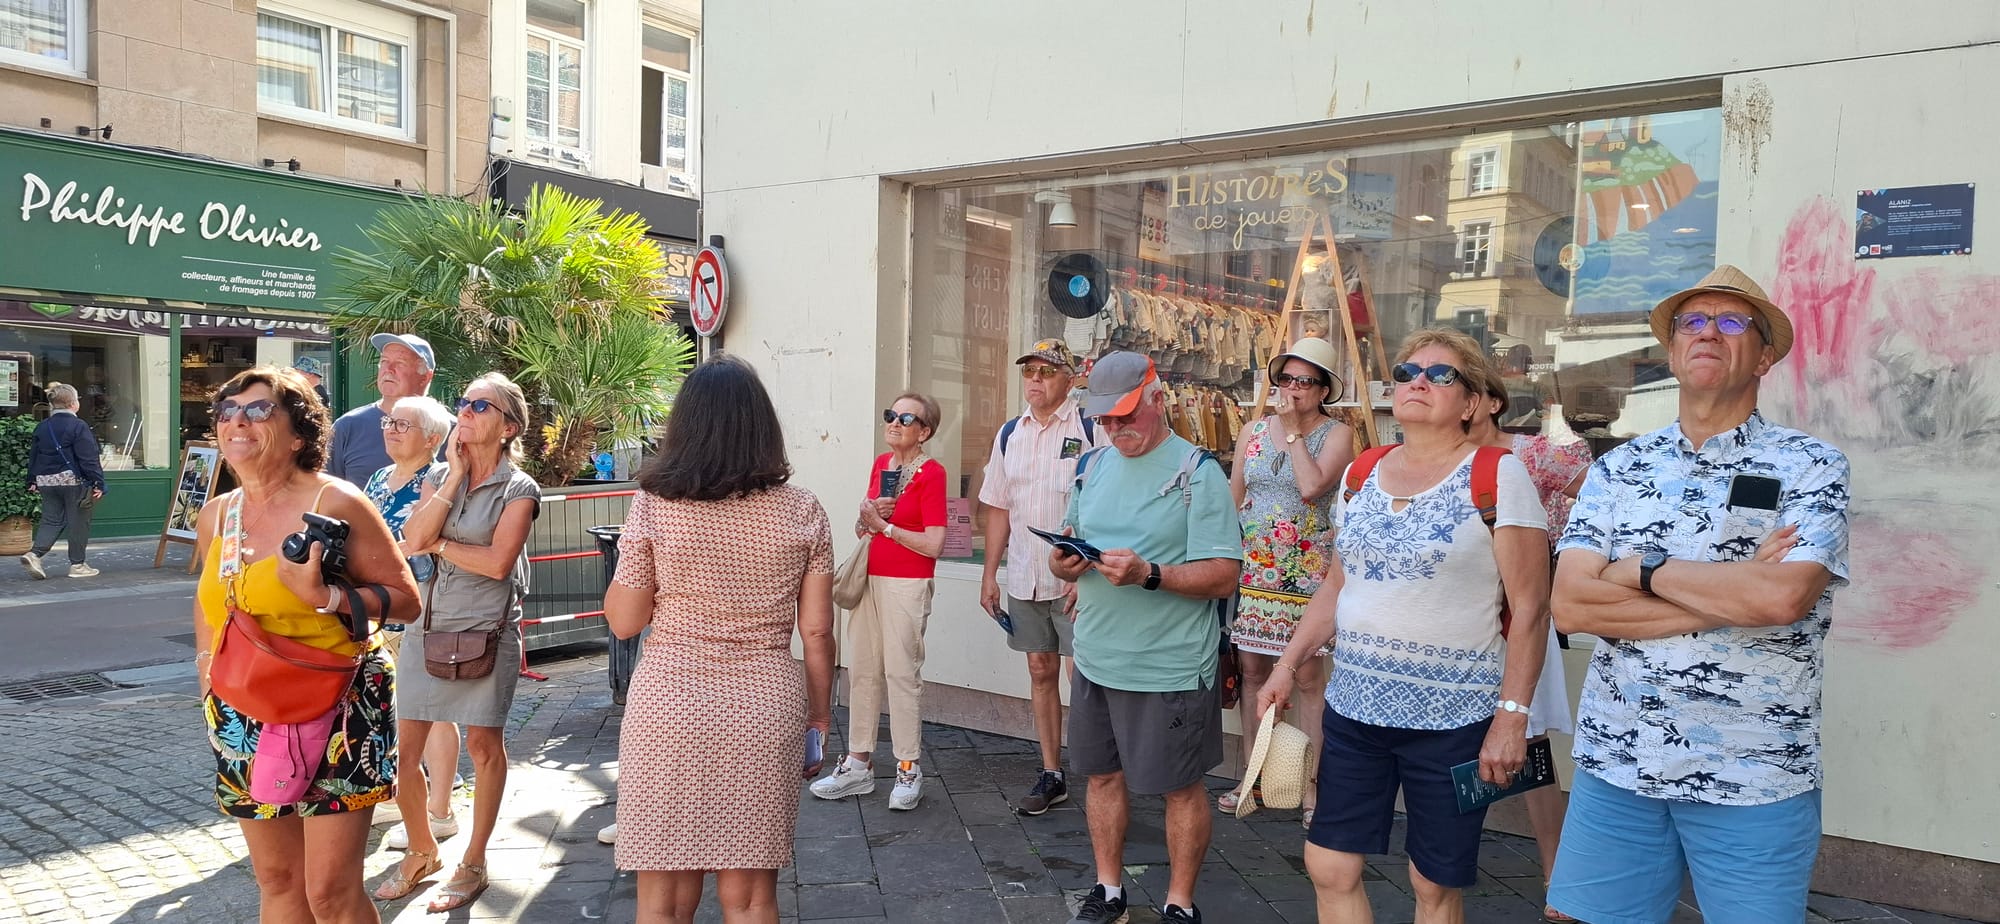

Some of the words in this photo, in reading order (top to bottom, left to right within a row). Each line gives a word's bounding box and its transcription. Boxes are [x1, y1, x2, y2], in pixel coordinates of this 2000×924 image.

[20, 172, 186, 247] Philippe
[199, 201, 322, 252] Olivier
[1195, 206, 1226, 231] de
[1233, 205, 1320, 250] jouets
[182, 271, 228, 283] collecteurs,
[230, 276, 264, 286] affineurs
[265, 279, 274, 287] et
[274, 280, 316, 290] marchands
[261, 269, 278, 279] Une
[279, 271, 304, 281] famille
[305, 273, 315, 282] de
[219, 283, 230, 292] de
[231, 285, 269, 296] fromages
[270, 288, 296, 298] depuis
[297, 290, 316, 299] 1907
